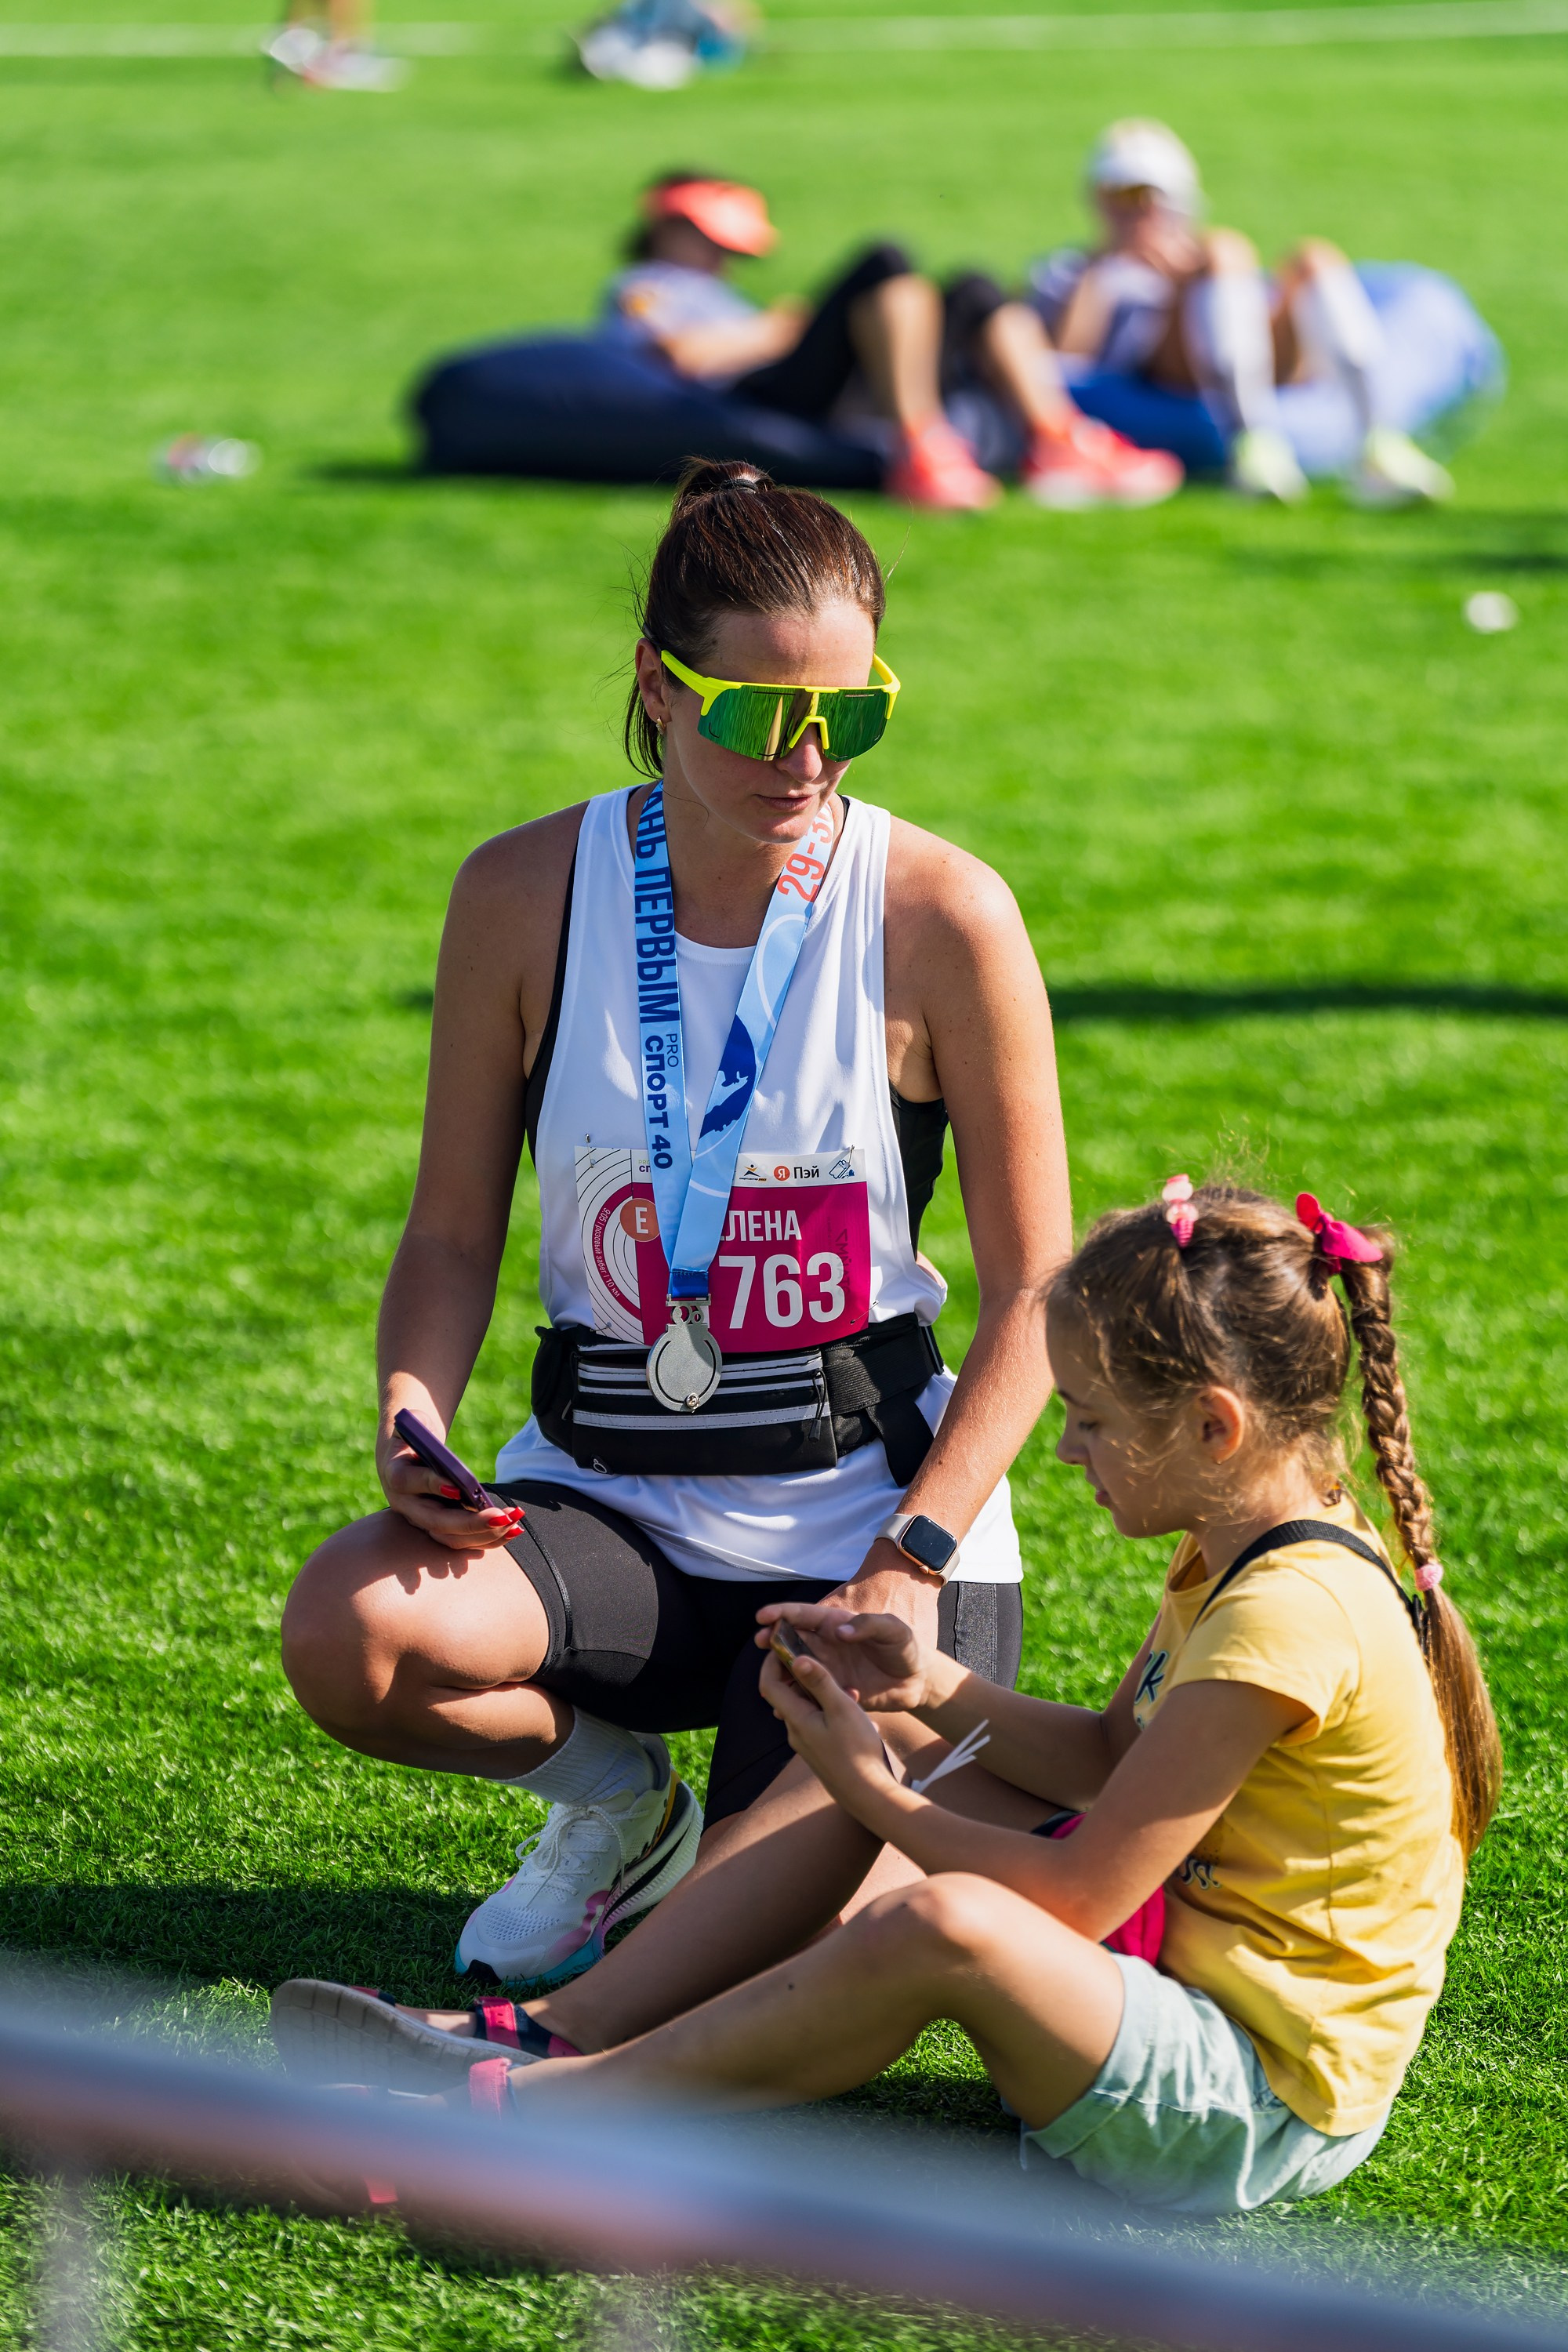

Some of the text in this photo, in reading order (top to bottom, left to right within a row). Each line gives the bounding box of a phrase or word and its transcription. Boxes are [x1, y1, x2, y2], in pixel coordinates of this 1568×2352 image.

[635, 782, 681, 1024] АНЬ ПЕРВЫМ
[666, 1033, 679, 1068] PRO
[645, 1035, 673, 1169] СПОРТ 40
[793, 1166, 820, 1179] Пэй
[593, 1224, 602, 1254] розовый
[720, 1210, 803, 1242] ЛЕНА
[596, 1255, 607, 1276] забег
[606, 1278, 615, 1287] 10
[611, 1287, 620, 1298] км
[707, 1251, 845, 1329] 763
